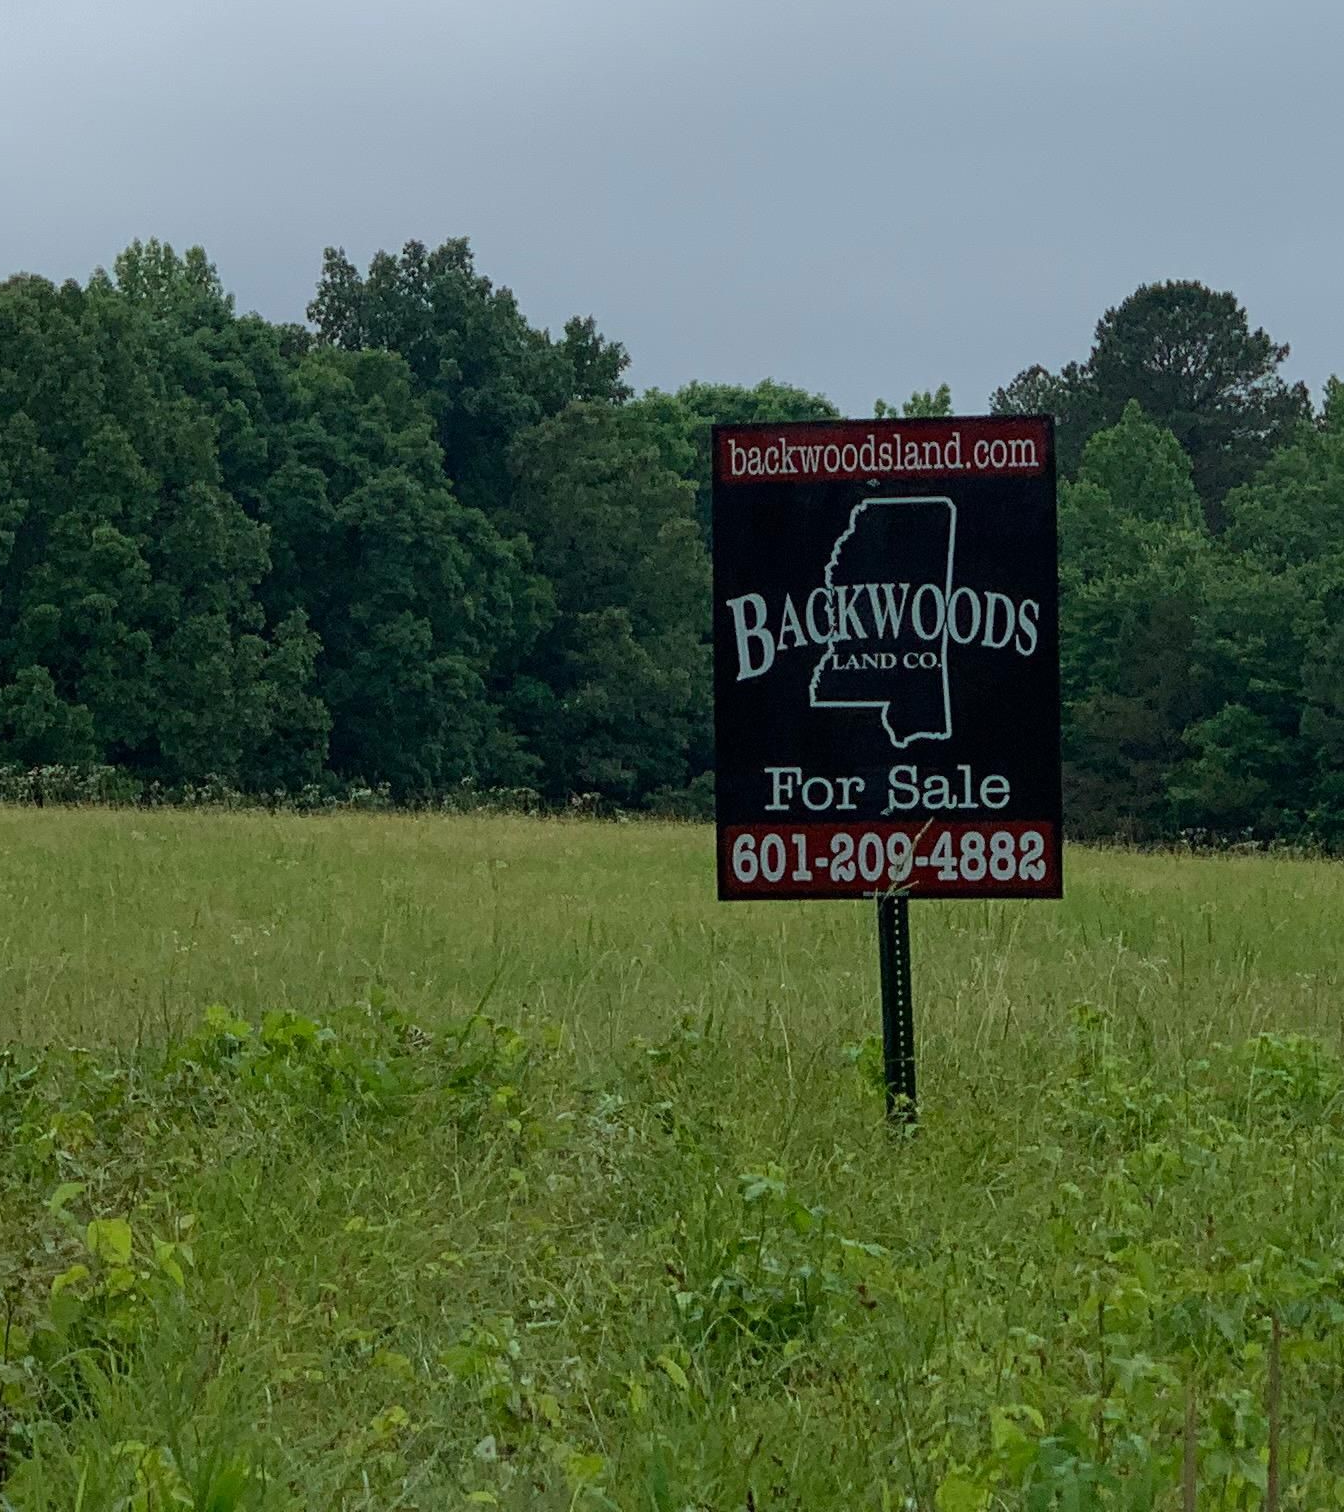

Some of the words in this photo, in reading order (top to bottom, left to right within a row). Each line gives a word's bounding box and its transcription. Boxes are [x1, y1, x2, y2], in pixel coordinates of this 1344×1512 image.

[728, 432, 1039, 475] backwoodsland.com
[726, 583, 1040, 681] BACKWOODS
[832, 653, 897, 670] LAND
[903, 652, 942, 669] CO.
[764, 766, 865, 810] For
[887, 764, 1010, 810] Sale
[732, 830, 1046, 883] 601-209-4882
